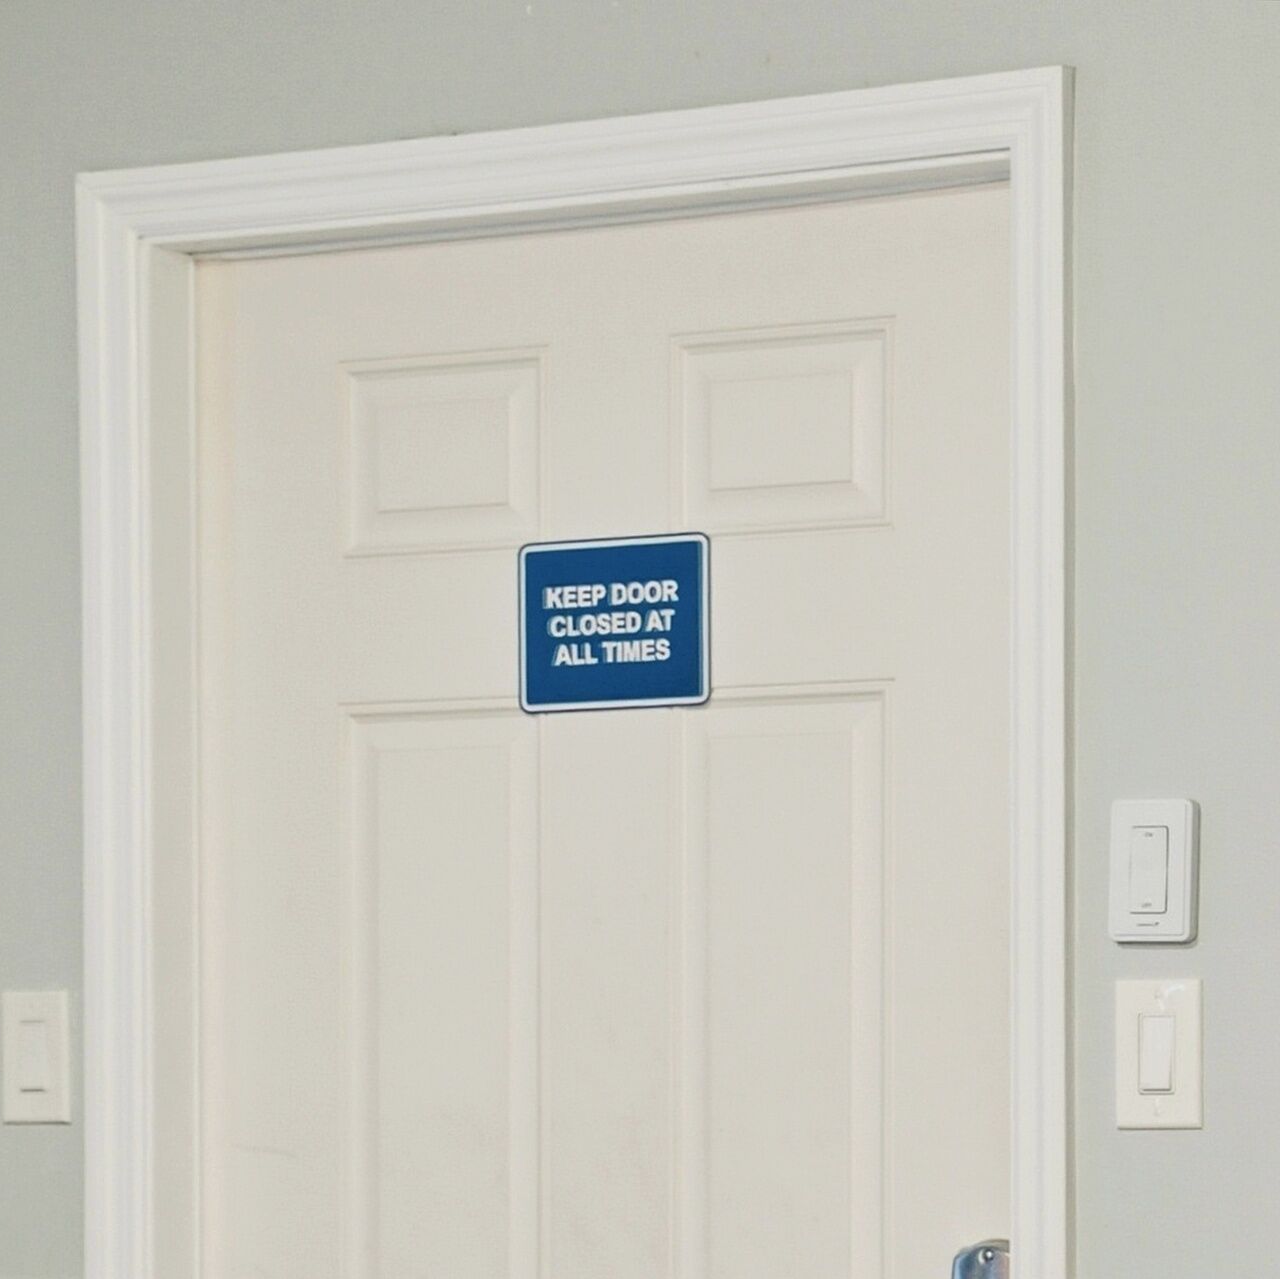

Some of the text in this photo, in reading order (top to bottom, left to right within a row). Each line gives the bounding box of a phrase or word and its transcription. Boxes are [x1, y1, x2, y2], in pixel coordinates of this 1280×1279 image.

[543, 579, 679, 609] KEEP DOOR
[548, 609, 675, 637] CLOSED AT
[552, 638, 671, 666] ALL TIMES
